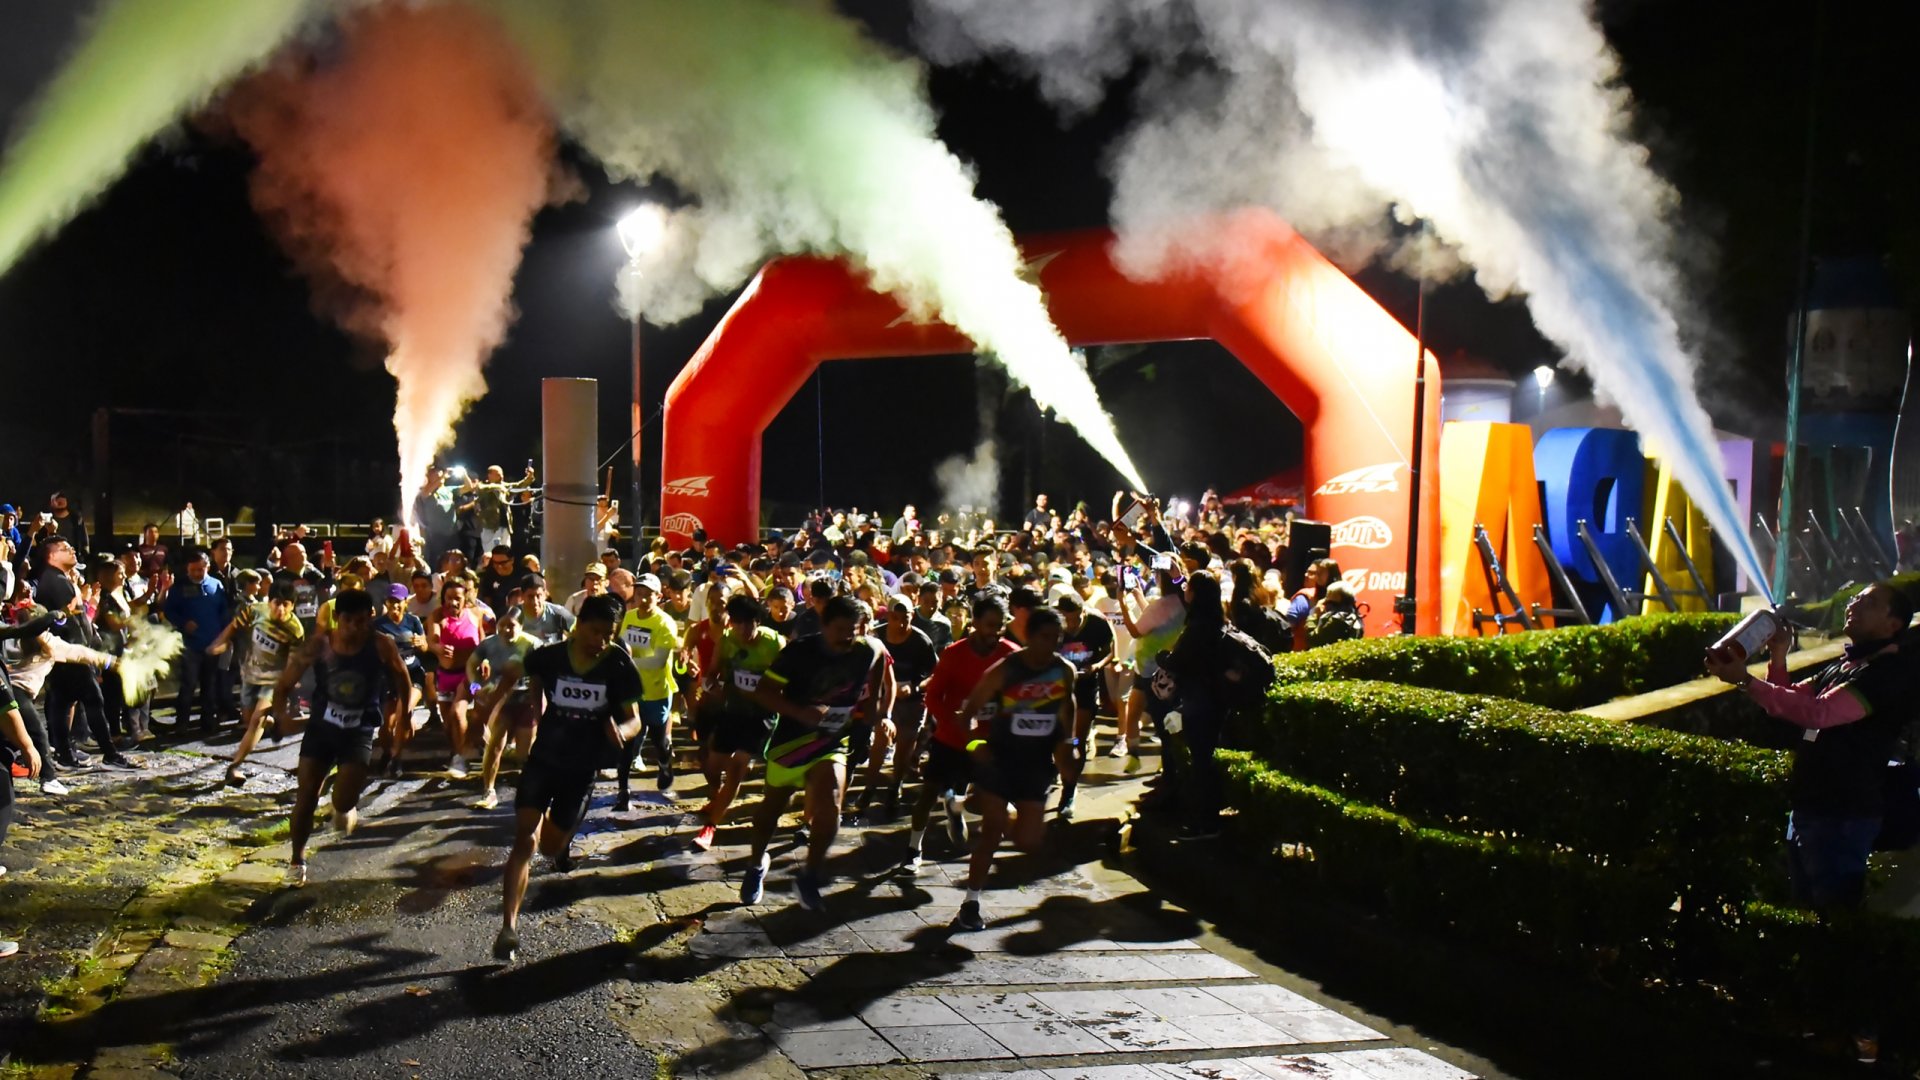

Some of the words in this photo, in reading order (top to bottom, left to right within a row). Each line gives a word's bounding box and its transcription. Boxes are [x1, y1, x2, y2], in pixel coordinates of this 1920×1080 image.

[1313, 481, 1400, 496] ALTRA
[665, 517, 690, 532] FOOT
[627, 633, 649, 645] 1117
[738, 676, 757, 687] 113
[562, 687, 600, 702] 0391
